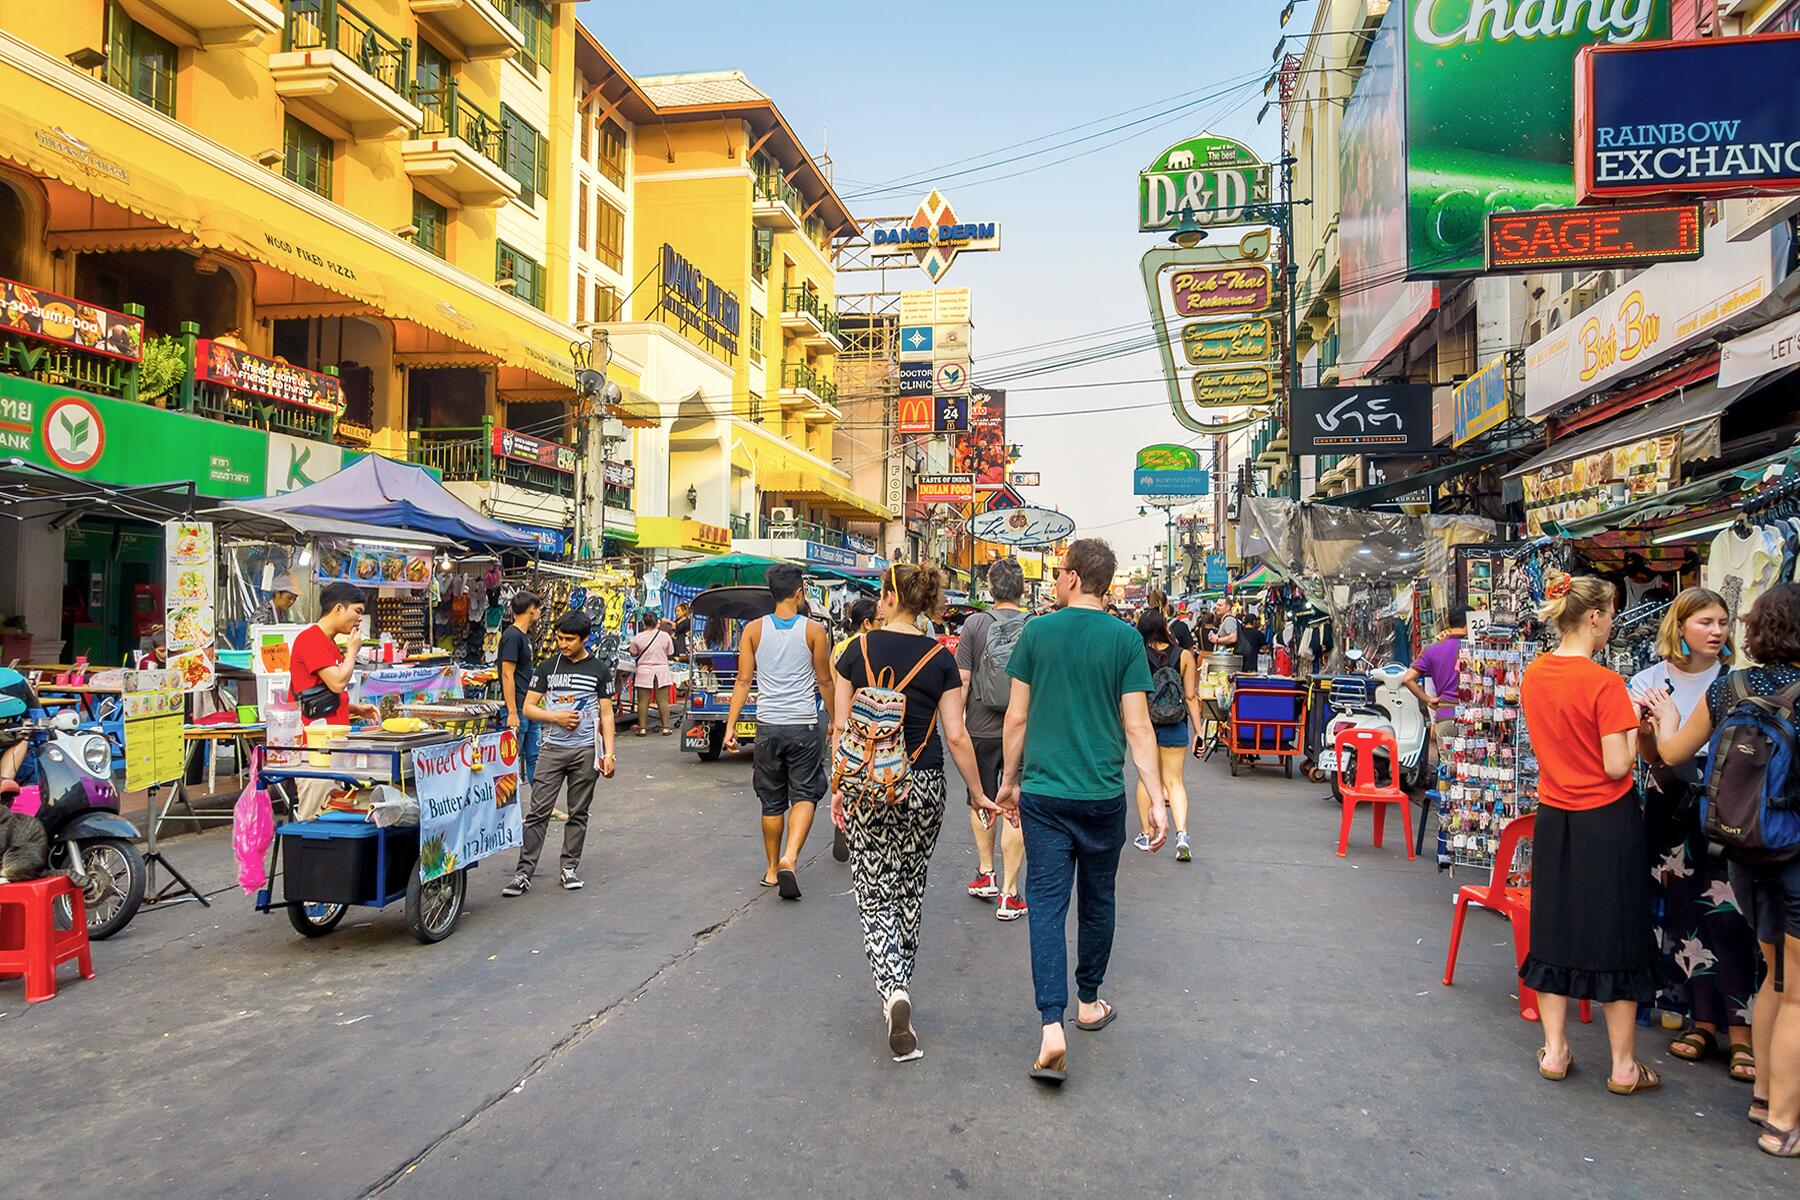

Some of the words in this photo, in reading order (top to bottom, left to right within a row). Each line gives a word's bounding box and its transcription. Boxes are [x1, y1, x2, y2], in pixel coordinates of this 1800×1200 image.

[1597, 120, 1741, 148] RAINBOW
[1208, 151, 1220, 160] The
[1221, 150, 1236, 159] best
[1144, 171, 1247, 228] D&D
[874, 226, 930, 245] DANG
[938, 223, 995, 242] DERM
[1494, 215, 1632, 257] SAGE.
[265, 232, 292, 254] WOOD
[296, 246, 323, 267] FIRED
[327, 260, 357, 280] PIZZA
[663, 243, 703, 309] DANG
[1186, 293, 1258, 310] Restaurant
[1579, 316, 1617, 382] Best
[1618, 289, 1660, 361] Bar
[1192, 343, 1229, 359] Beauty
[900, 369, 932, 378] DOCTOR
[900, 380, 932, 390] CLINIC
[0, 398, 32, 421] ทย
[943, 408, 959, 420] 24
[890, 465, 900, 512] FOOD
[920, 485, 949, 494] INDIAN
[950, 484, 972, 494] FOOD
[921, 476, 941, 484] TASTE
[951, 475, 970, 483] INDIA
[978, 516, 1008, 537] The
[1024, 520, 1069, 538] Club
[1472, 620, 1486, 629] 20
[417, 751, 457, 780] Sweet
[460, 736, 497, 769] Crn
[429, 792, 463, 819] Butter
[473, 782, 493, 804] Salt
